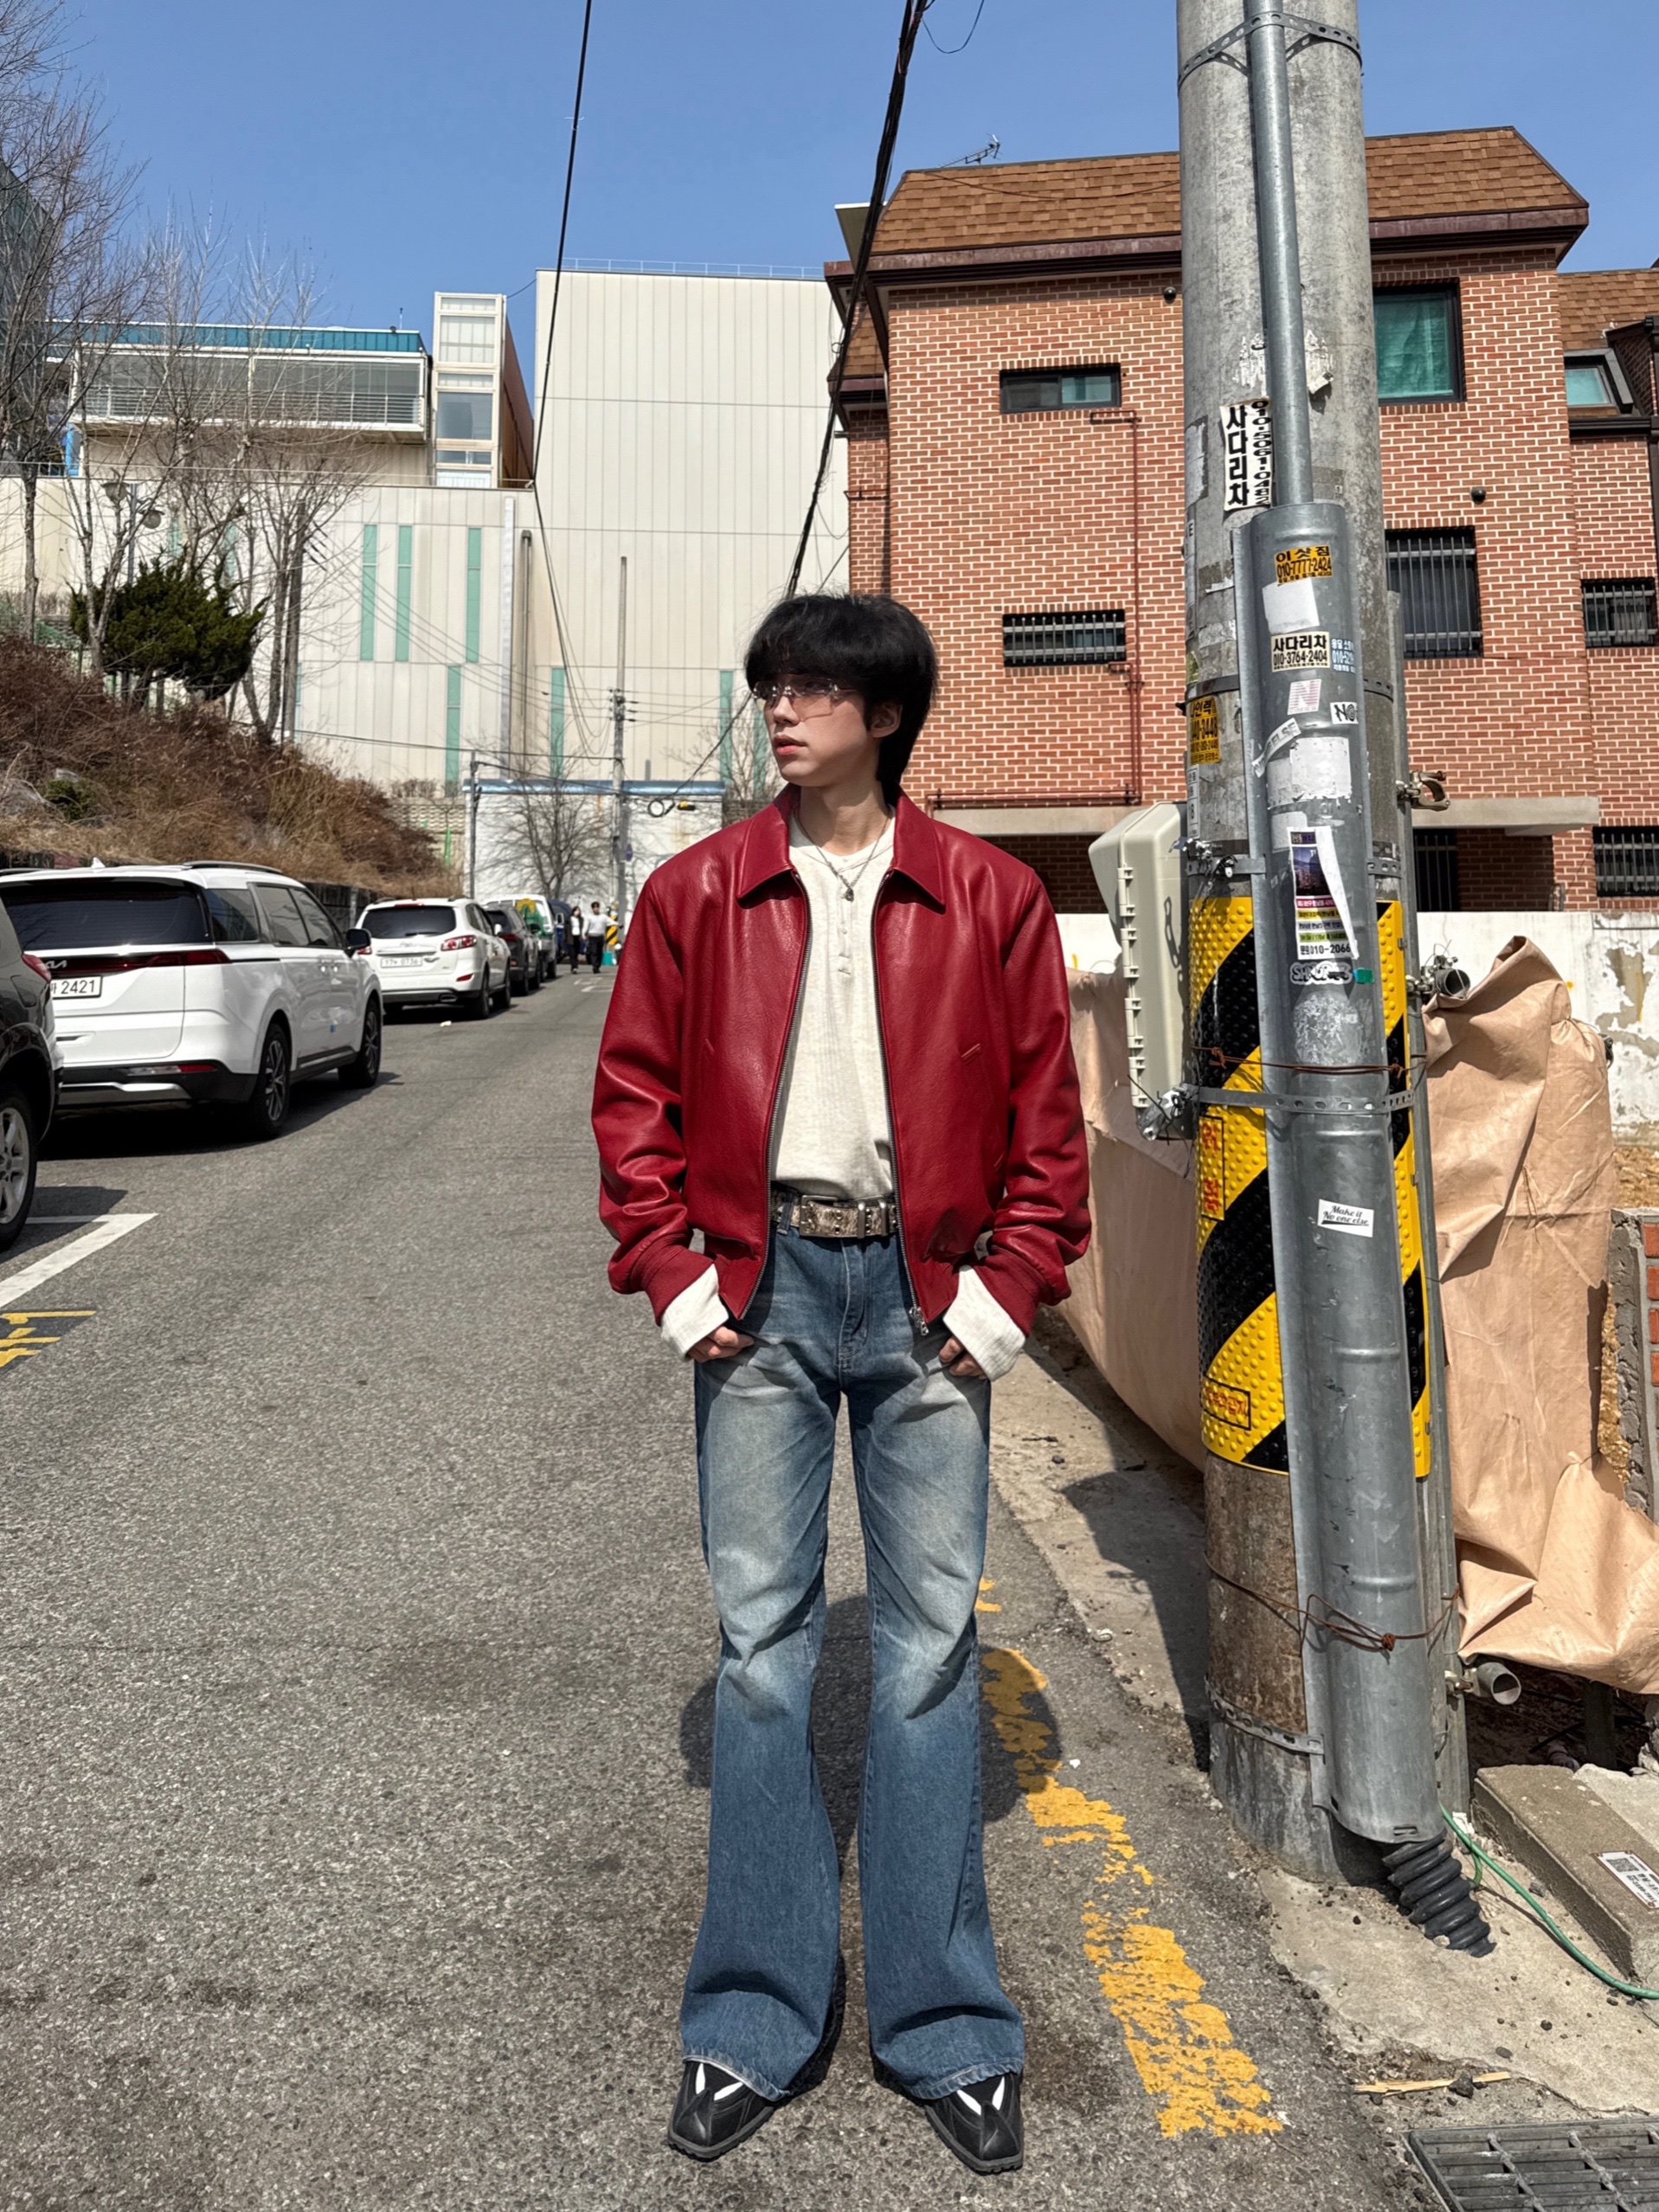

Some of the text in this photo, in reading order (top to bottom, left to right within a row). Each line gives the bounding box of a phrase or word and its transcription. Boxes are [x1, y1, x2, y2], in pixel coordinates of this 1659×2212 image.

[1226, 404, 1249, 506] 사다리차
[1276, 556, 1332, 579] 010-7777-2424
[1273, 634, 1327, 652] 사다리차
[61, 979, 94, 994] 2421
[1331, 1205, 1355, 1217] Make
